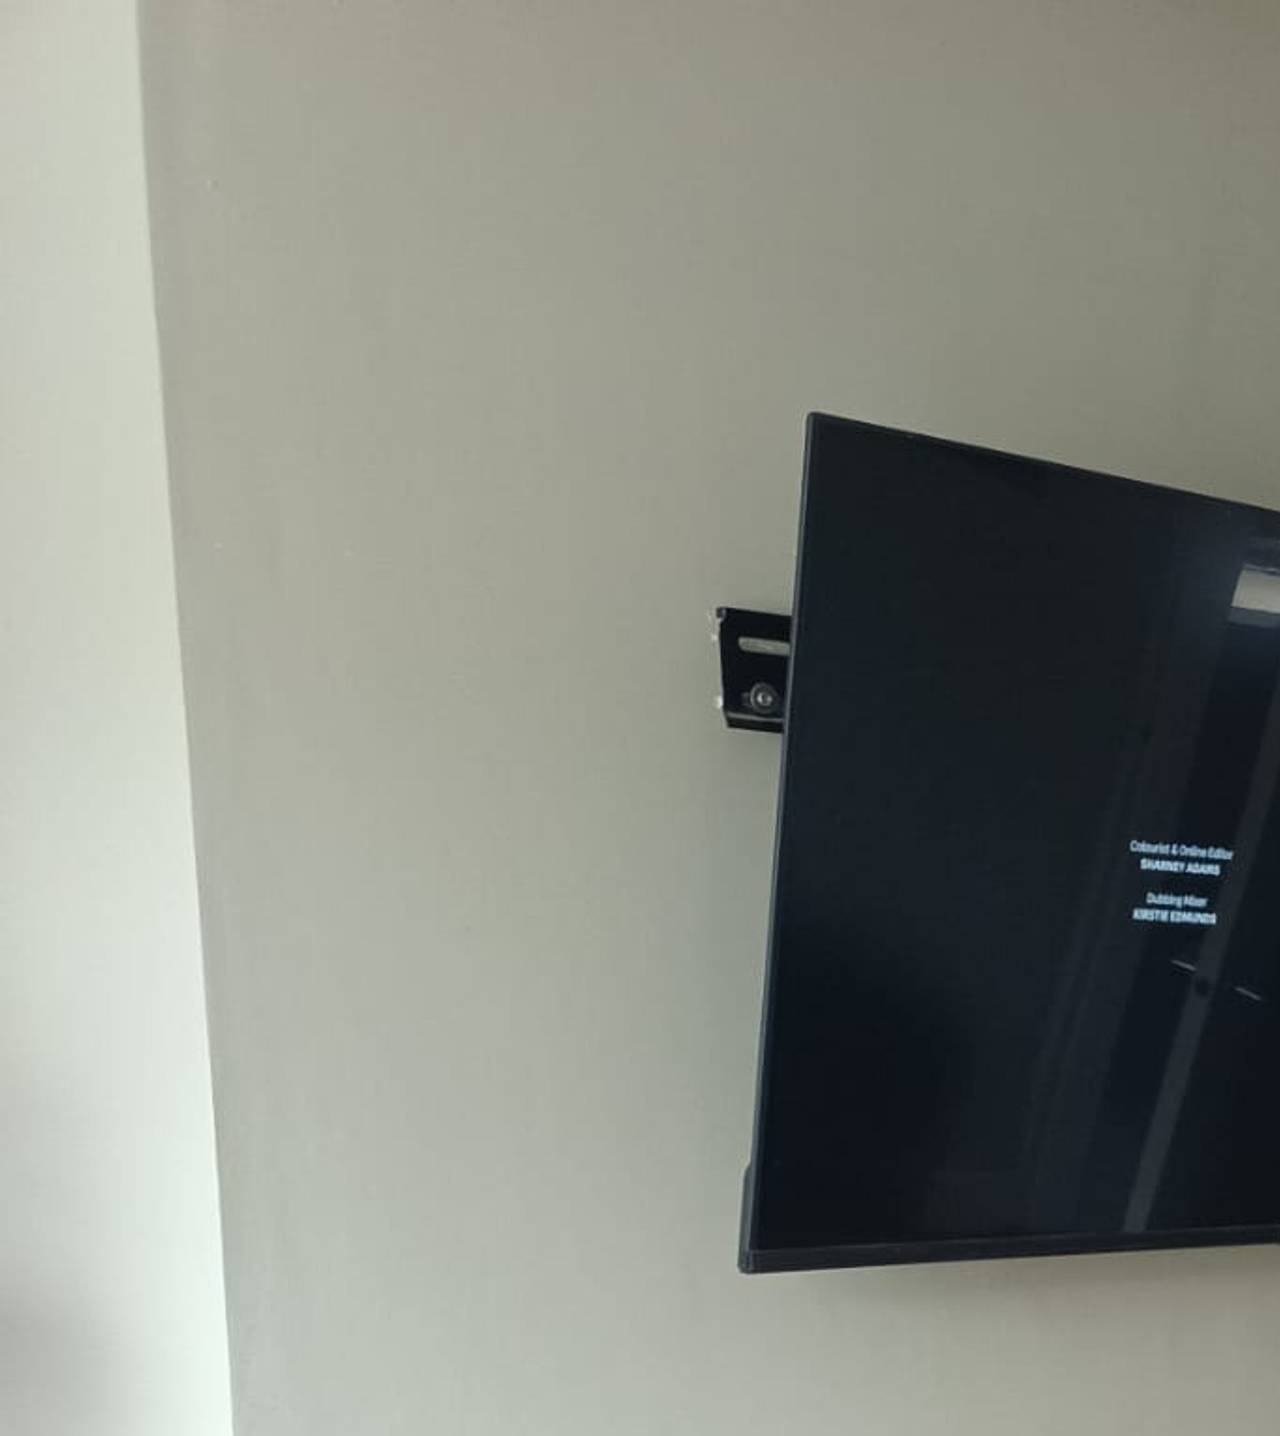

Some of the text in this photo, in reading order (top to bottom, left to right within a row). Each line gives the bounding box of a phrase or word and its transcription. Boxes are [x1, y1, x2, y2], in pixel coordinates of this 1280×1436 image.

[1130, 840, 1170, 857] Colourist
[1180, 845, 1208, 859] Online
[1208, 847, 1234, 860] Editor
[1146, 892, 1208, 908] Dubbing Mixer
[1133, 908, 1217, 925] KIRSTIE EDMUNDS
